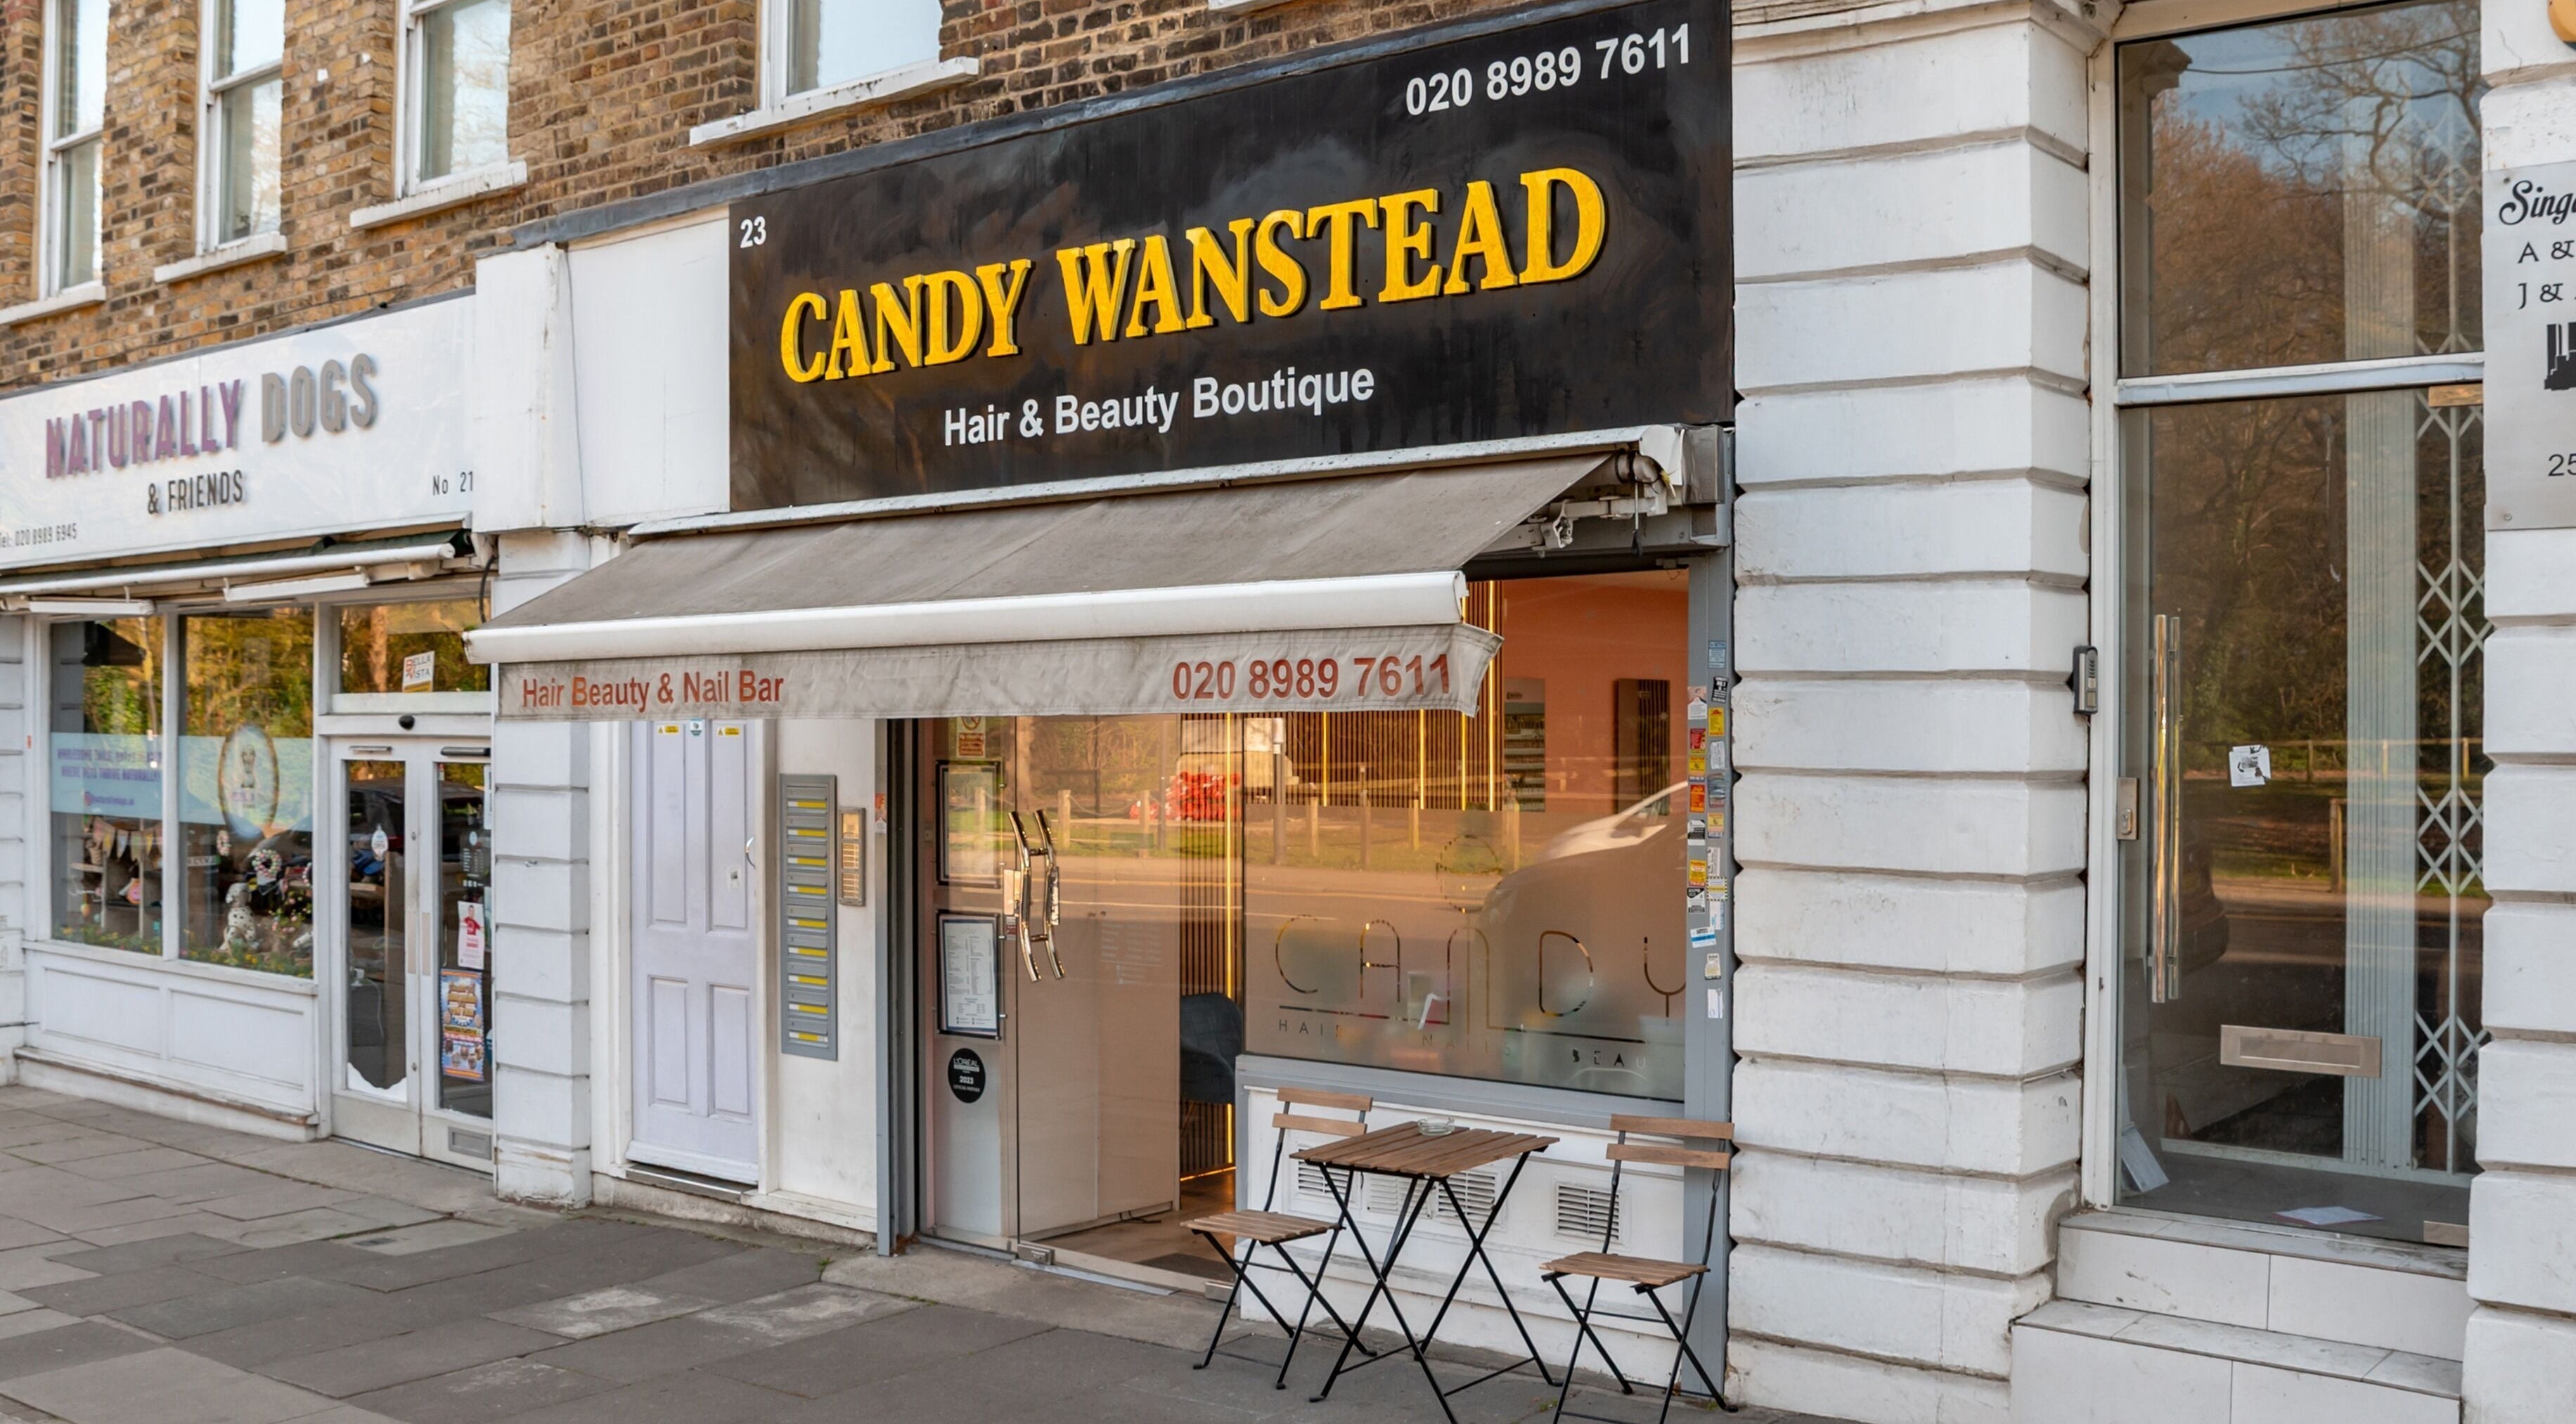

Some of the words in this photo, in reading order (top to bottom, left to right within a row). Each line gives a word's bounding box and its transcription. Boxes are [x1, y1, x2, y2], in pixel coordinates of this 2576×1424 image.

[1405, 67, 1473, 116] 020
[1486, 46, 1582, 101] 8989
[1595, 22, 1689, 81] 7611
[740, 215, 766, 249] 23
[2517, 241, 2540, 264] A
[2551, 240, 2575, 260] &
[780, 257, 1033, 384] CANDY
[1056, 167, 1607, 345] WANSTEAD
[2517, 283, 2527, 310] J
[2539, 283, 2564, 303] &
[45, 378, 242, 479] NATURALLY
[261, 353, 378, 443] DOGS
[944, 404, 1010, 446] Hair
[1019, 398, 1044, 439] &
[1055, 386, 1180, 434] Beauty
[1194, 366, 1375, 418] Boutique
[148, 483, 159, 515] &
[168, 470, 244, 514] FRIENDS
[432, 474, 449, 496] No
[460, 470, 473, 493] 21
[15, 529, 30, 546] 020
[33, 526, 52, 545] 8989
[522, 678, 565, 708] Hair
[571, 676, 650, 713] Beauty
[657, 672, 674, 704] &
[683, 671, 730, 703] Nail
[738, 670, 785, 702] Bar
[1172, 661, 1236, 700] 020
[1248, 658, 1339, 699] 8989
[1353, 653, 1450, 697] 7611
